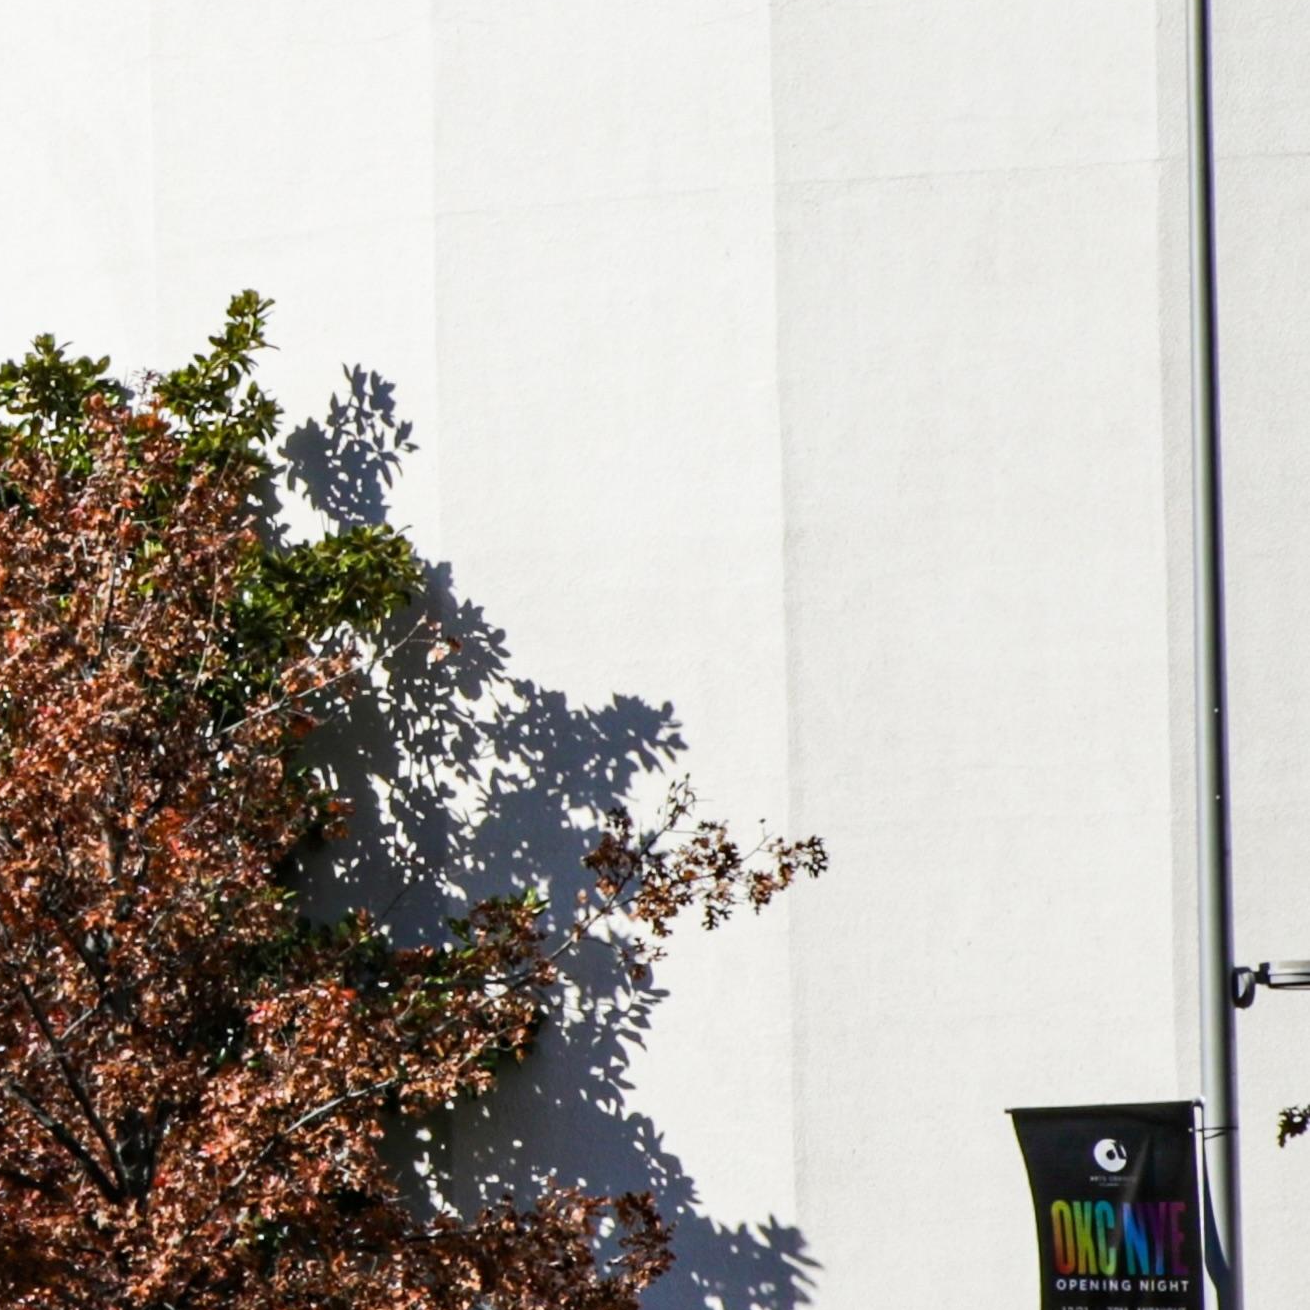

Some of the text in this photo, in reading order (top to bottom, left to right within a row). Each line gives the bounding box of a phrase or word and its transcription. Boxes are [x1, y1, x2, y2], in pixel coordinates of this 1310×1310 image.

[1051, 1200, 1188, 1277] OKC NYE
[1056, 1278, 1189, 1293] OPENING NIGHT
